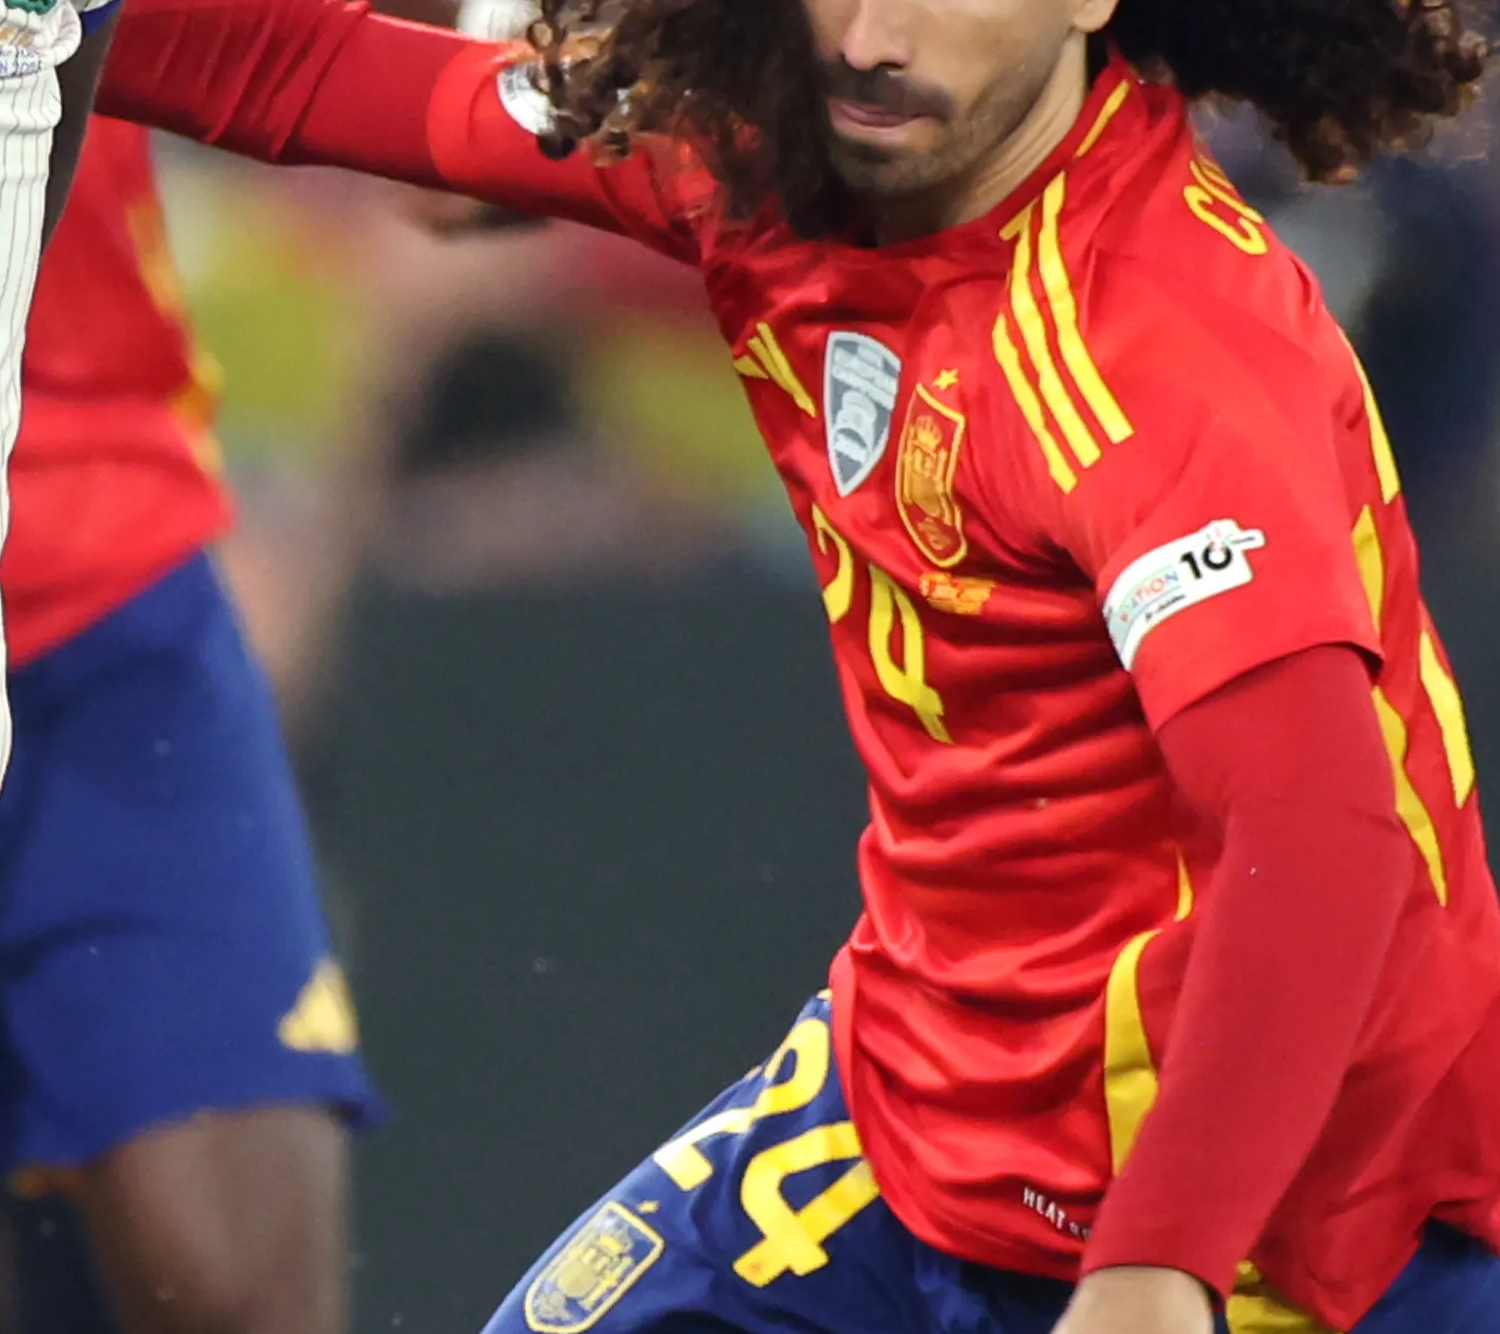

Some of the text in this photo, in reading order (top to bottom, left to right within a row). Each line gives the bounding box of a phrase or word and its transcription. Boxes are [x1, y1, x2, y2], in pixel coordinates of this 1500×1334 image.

[1179, 540, 1233, 581] 10
[653, 1017, 880, 1288] 24
[1022, 1186, 1067, 1230] HEAT
